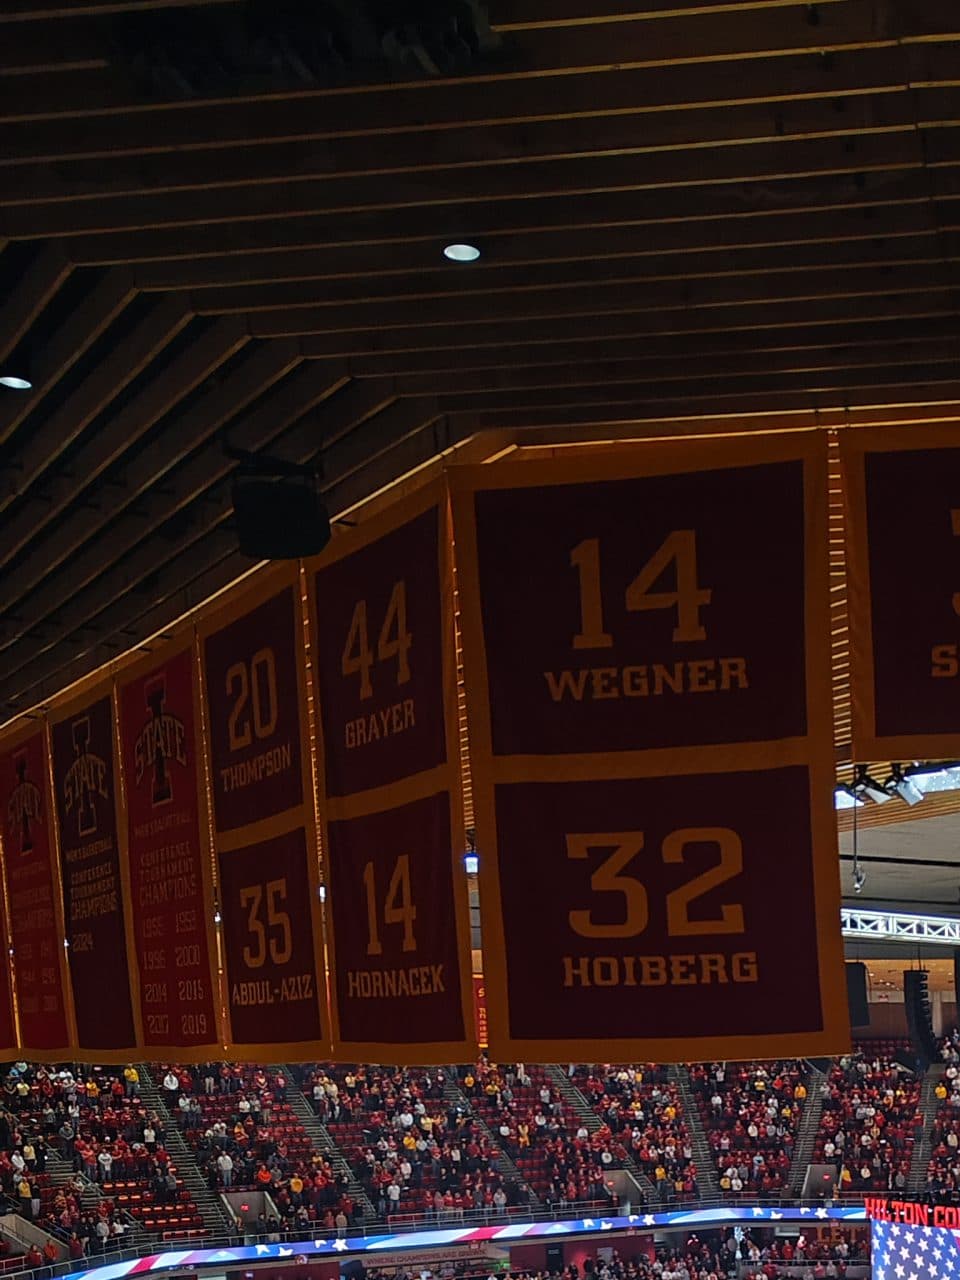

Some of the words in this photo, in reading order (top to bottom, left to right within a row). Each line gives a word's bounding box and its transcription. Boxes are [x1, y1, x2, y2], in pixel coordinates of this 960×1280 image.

[570, 529, 712, 649] 14
[342, 581, 412, 701] 44
[225, 647, 279, 751] 20
[545, 657, 749, 703] WEGNER
[345, 698, 416, 749] GRAYER
[220, 742, 293, 793] THOMPSON
[362, 854, 417, 956] 14
[566, 827, 747, 940] 32
[240, 878, 292, 968] 35
[175, 944, 201, 968] 2000
[348, 964, 445, 999] HORNACEK
[564, 951, 759, 987] HOIBERG
[233, 967, 313, 1006] ABDUL-AZIZ
[181, 1013, 209, 1034] 2019
[864, 1198, 929, 1226] HILTON
